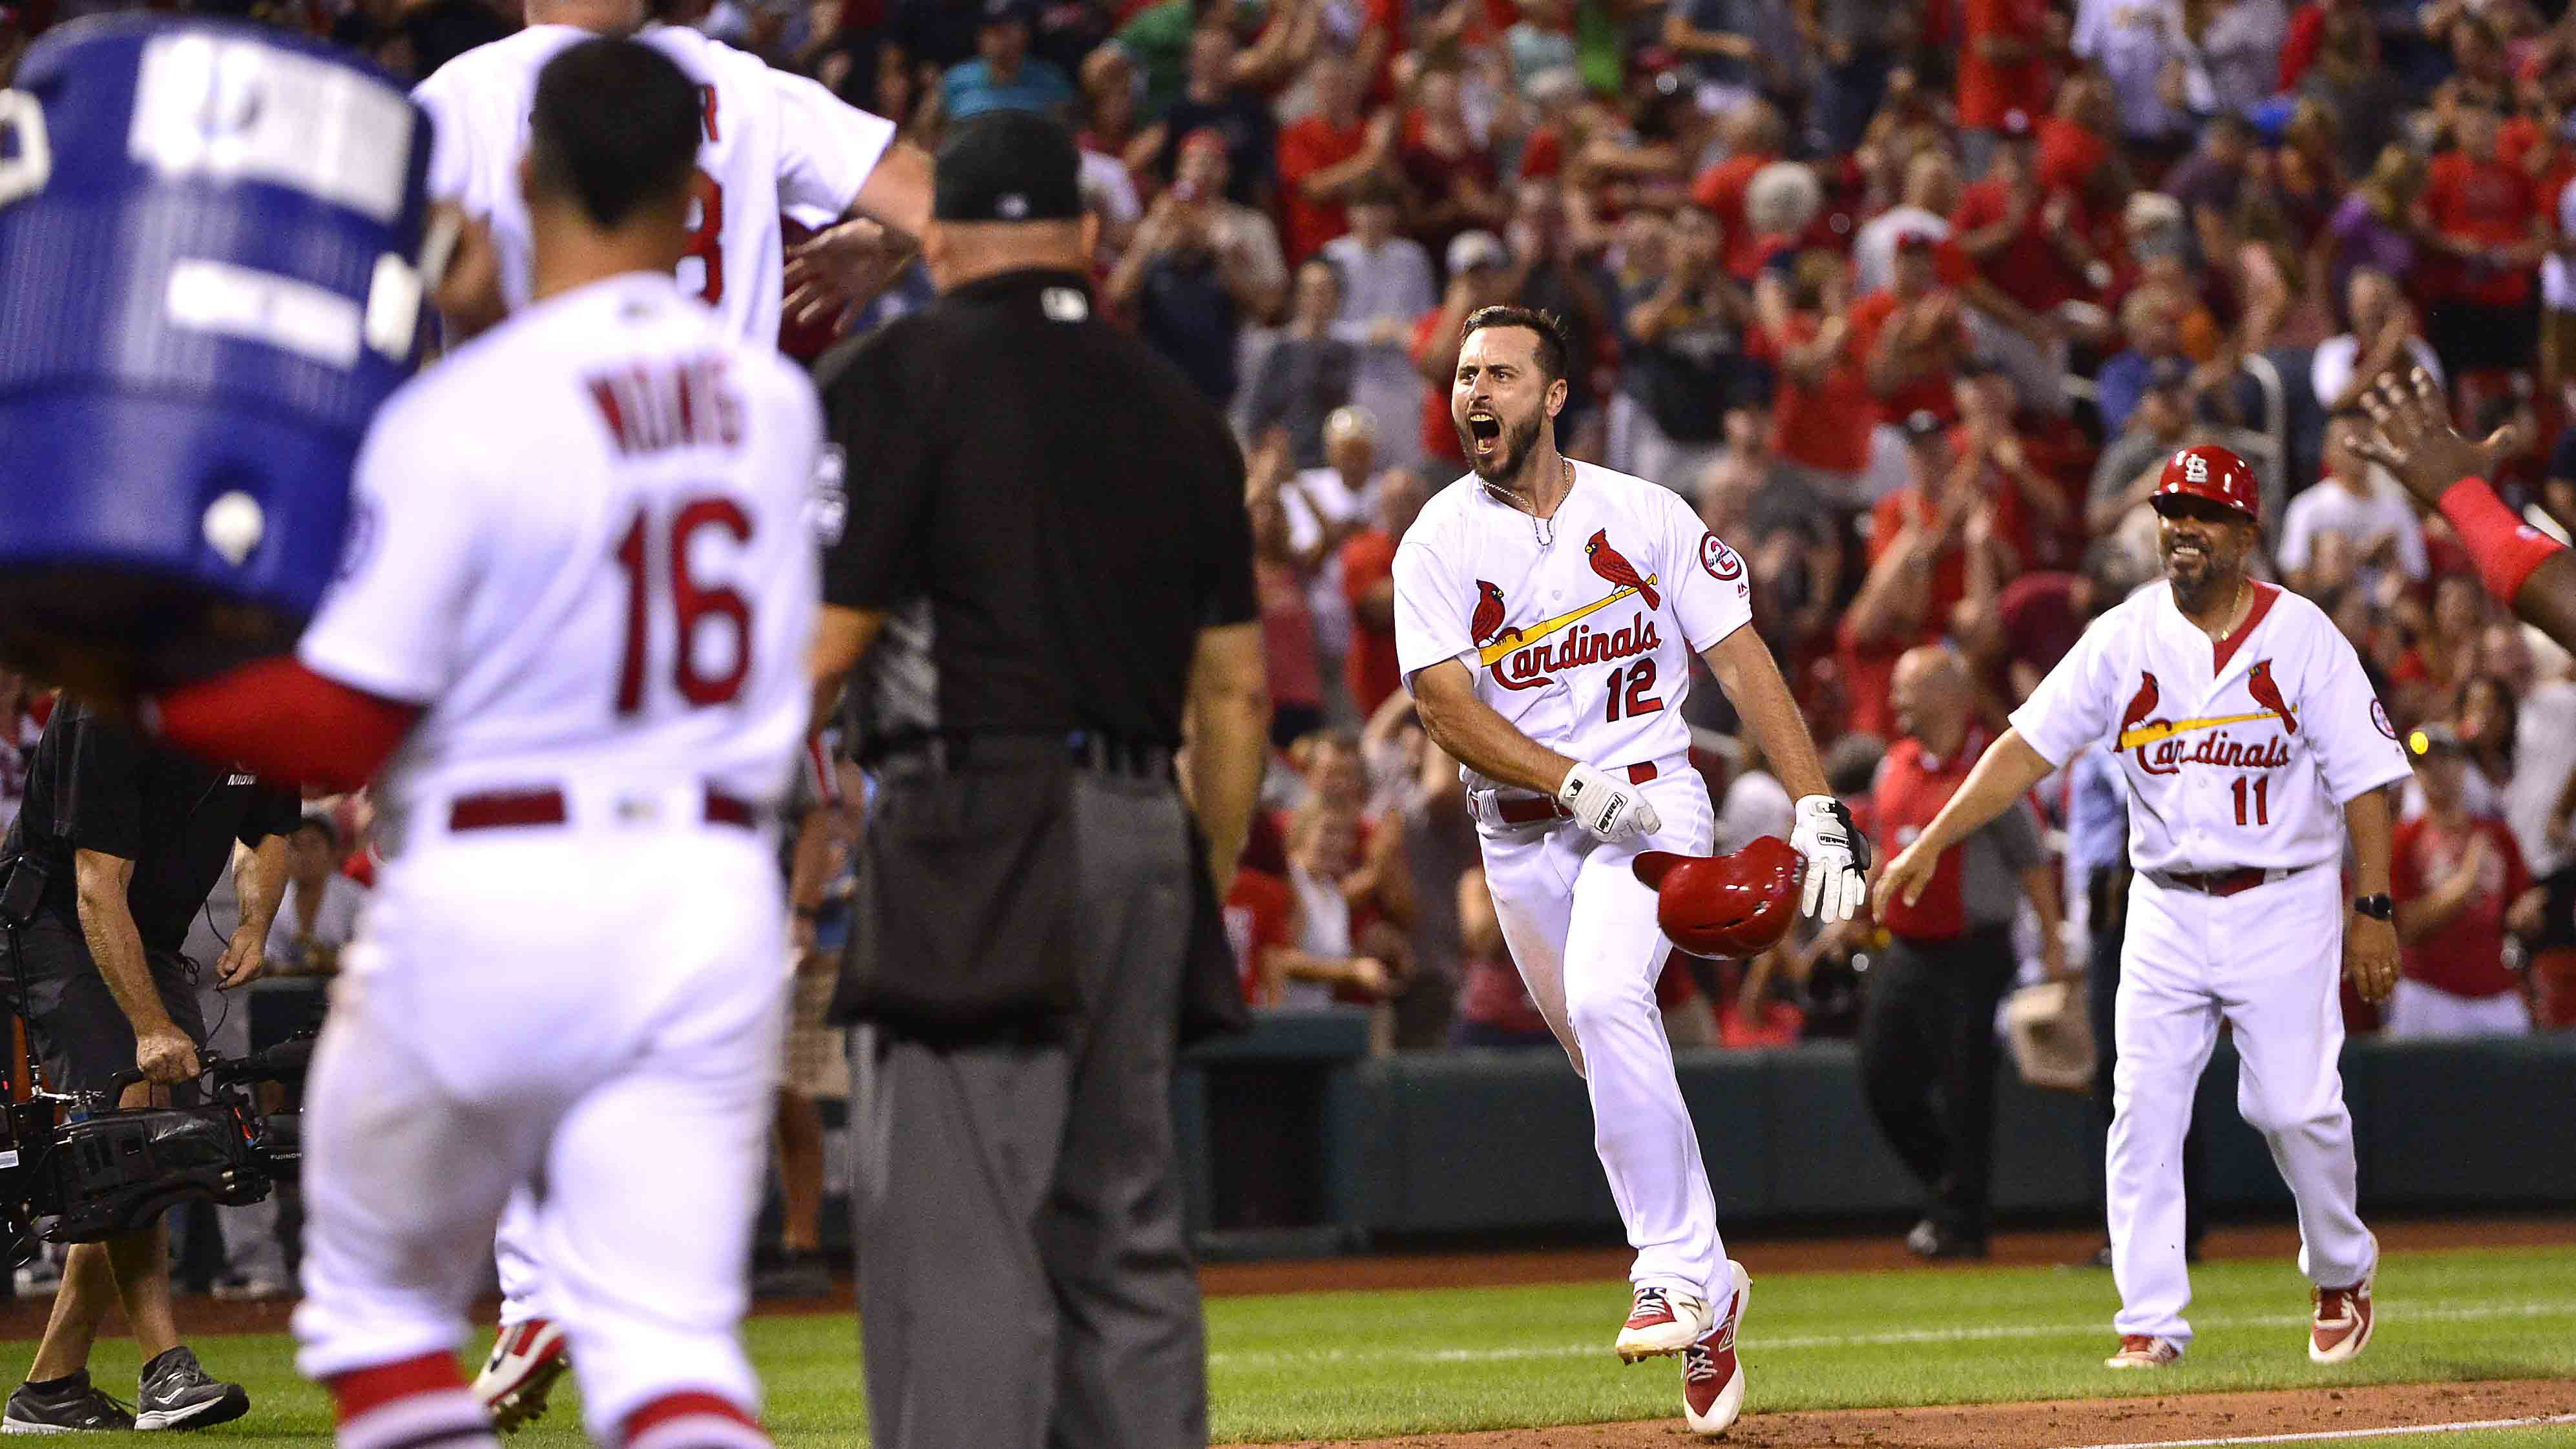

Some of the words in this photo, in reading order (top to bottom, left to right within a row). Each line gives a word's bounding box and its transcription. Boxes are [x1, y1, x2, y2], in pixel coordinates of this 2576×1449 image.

[614, 495, 756, 718] 16
[1491, 611, 1662, 691] Cardinals
[1607, 657, 1665, 723] 12
[2135, 718, 2290, 775] Cardinals
[2231, 775, 2269, 826] 11
